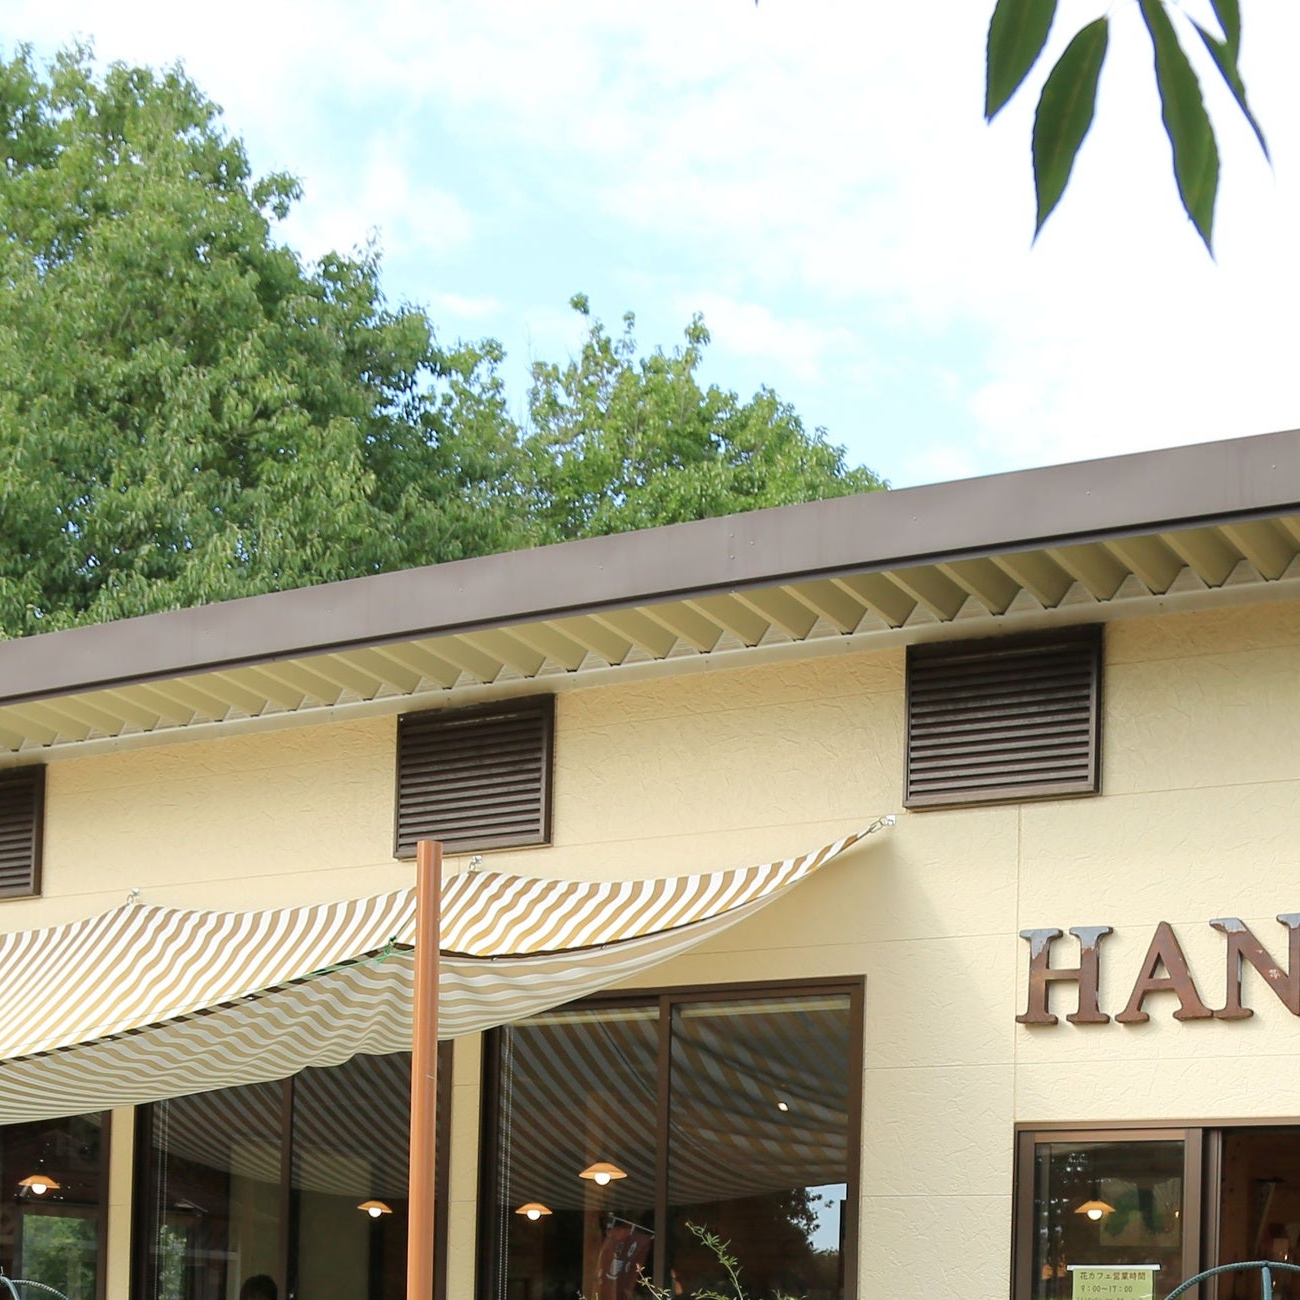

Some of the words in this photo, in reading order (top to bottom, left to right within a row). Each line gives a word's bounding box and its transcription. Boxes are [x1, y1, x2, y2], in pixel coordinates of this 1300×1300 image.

[1080, 1271, 1147, 1281] 花カフェ営業時間
